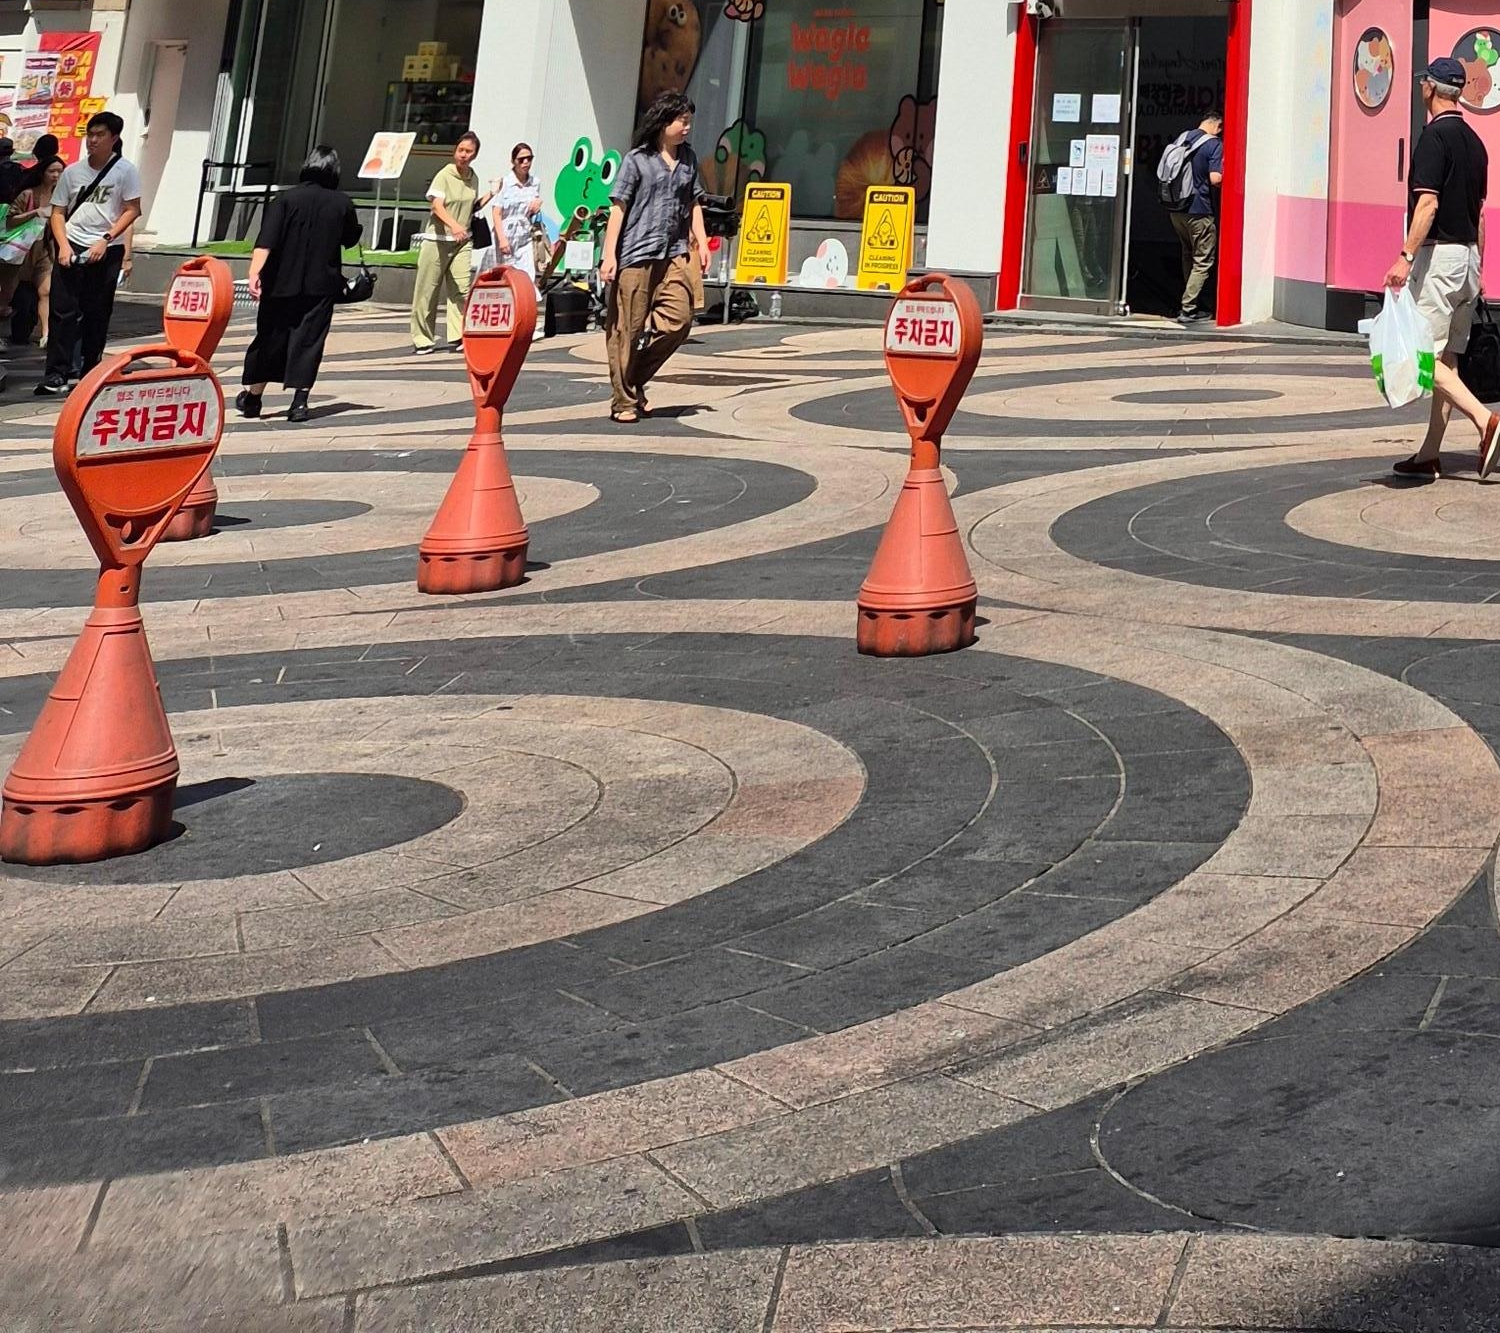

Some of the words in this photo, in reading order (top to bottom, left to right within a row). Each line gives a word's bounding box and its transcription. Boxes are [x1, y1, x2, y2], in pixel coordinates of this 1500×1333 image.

[751, 189, 782, 199] CAUTION
[873, 193, 905, 203] CAUTION
[868, 254, 896, 262] CLEANING
[172, 290, 210, 313] 주차금지
[470, 303, 511, 327] 주차금지
[894, 317, 954, 348] 주차금지
[91, 401, 207, 446] 주차금지
